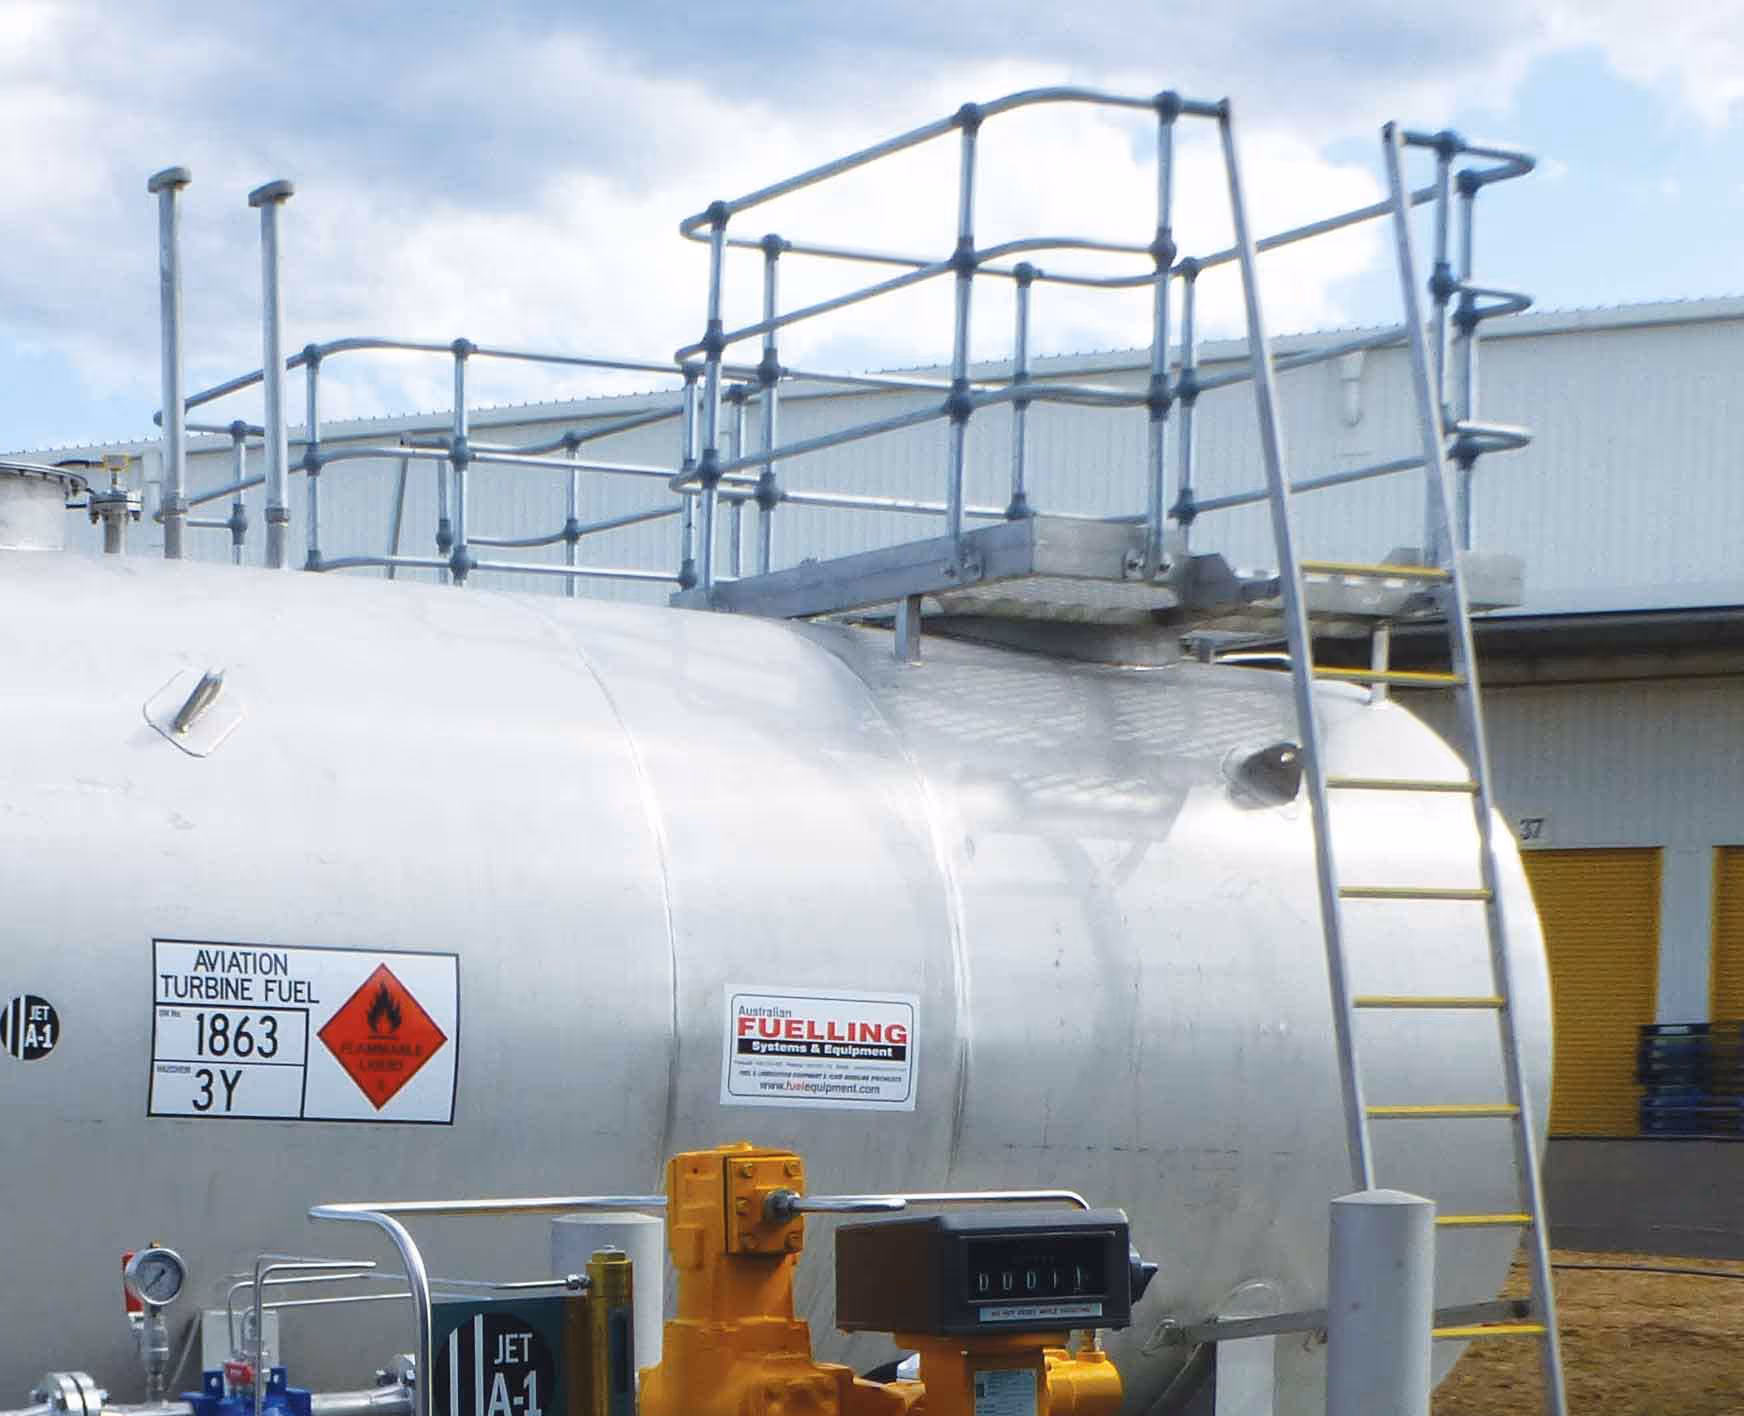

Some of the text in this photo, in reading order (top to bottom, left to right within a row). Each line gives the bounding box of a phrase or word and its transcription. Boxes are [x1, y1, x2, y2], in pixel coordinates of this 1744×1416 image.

[1519, 817, 1545, 841] 37
[193, 950, 288, 976] AVIATION
[160, 974, 320, 1004] TURBINE FUEL
[29, 1005, 50, 1021] JET
[738, 1005, 792, 1019] Australian
[24, 1023, 53, 1048] A-1
[196, 1013, 278, 1059] 1863
[737, 1017, 908, 1044] FUELLING
[752, 1041, 893, 1058] Systems & Equipment
[192, 1069, 243, 1112] 3Y
[760, 1080, 880, 1095] www.fuelequipment.com
[494, 1332, 533, 1364] JET
